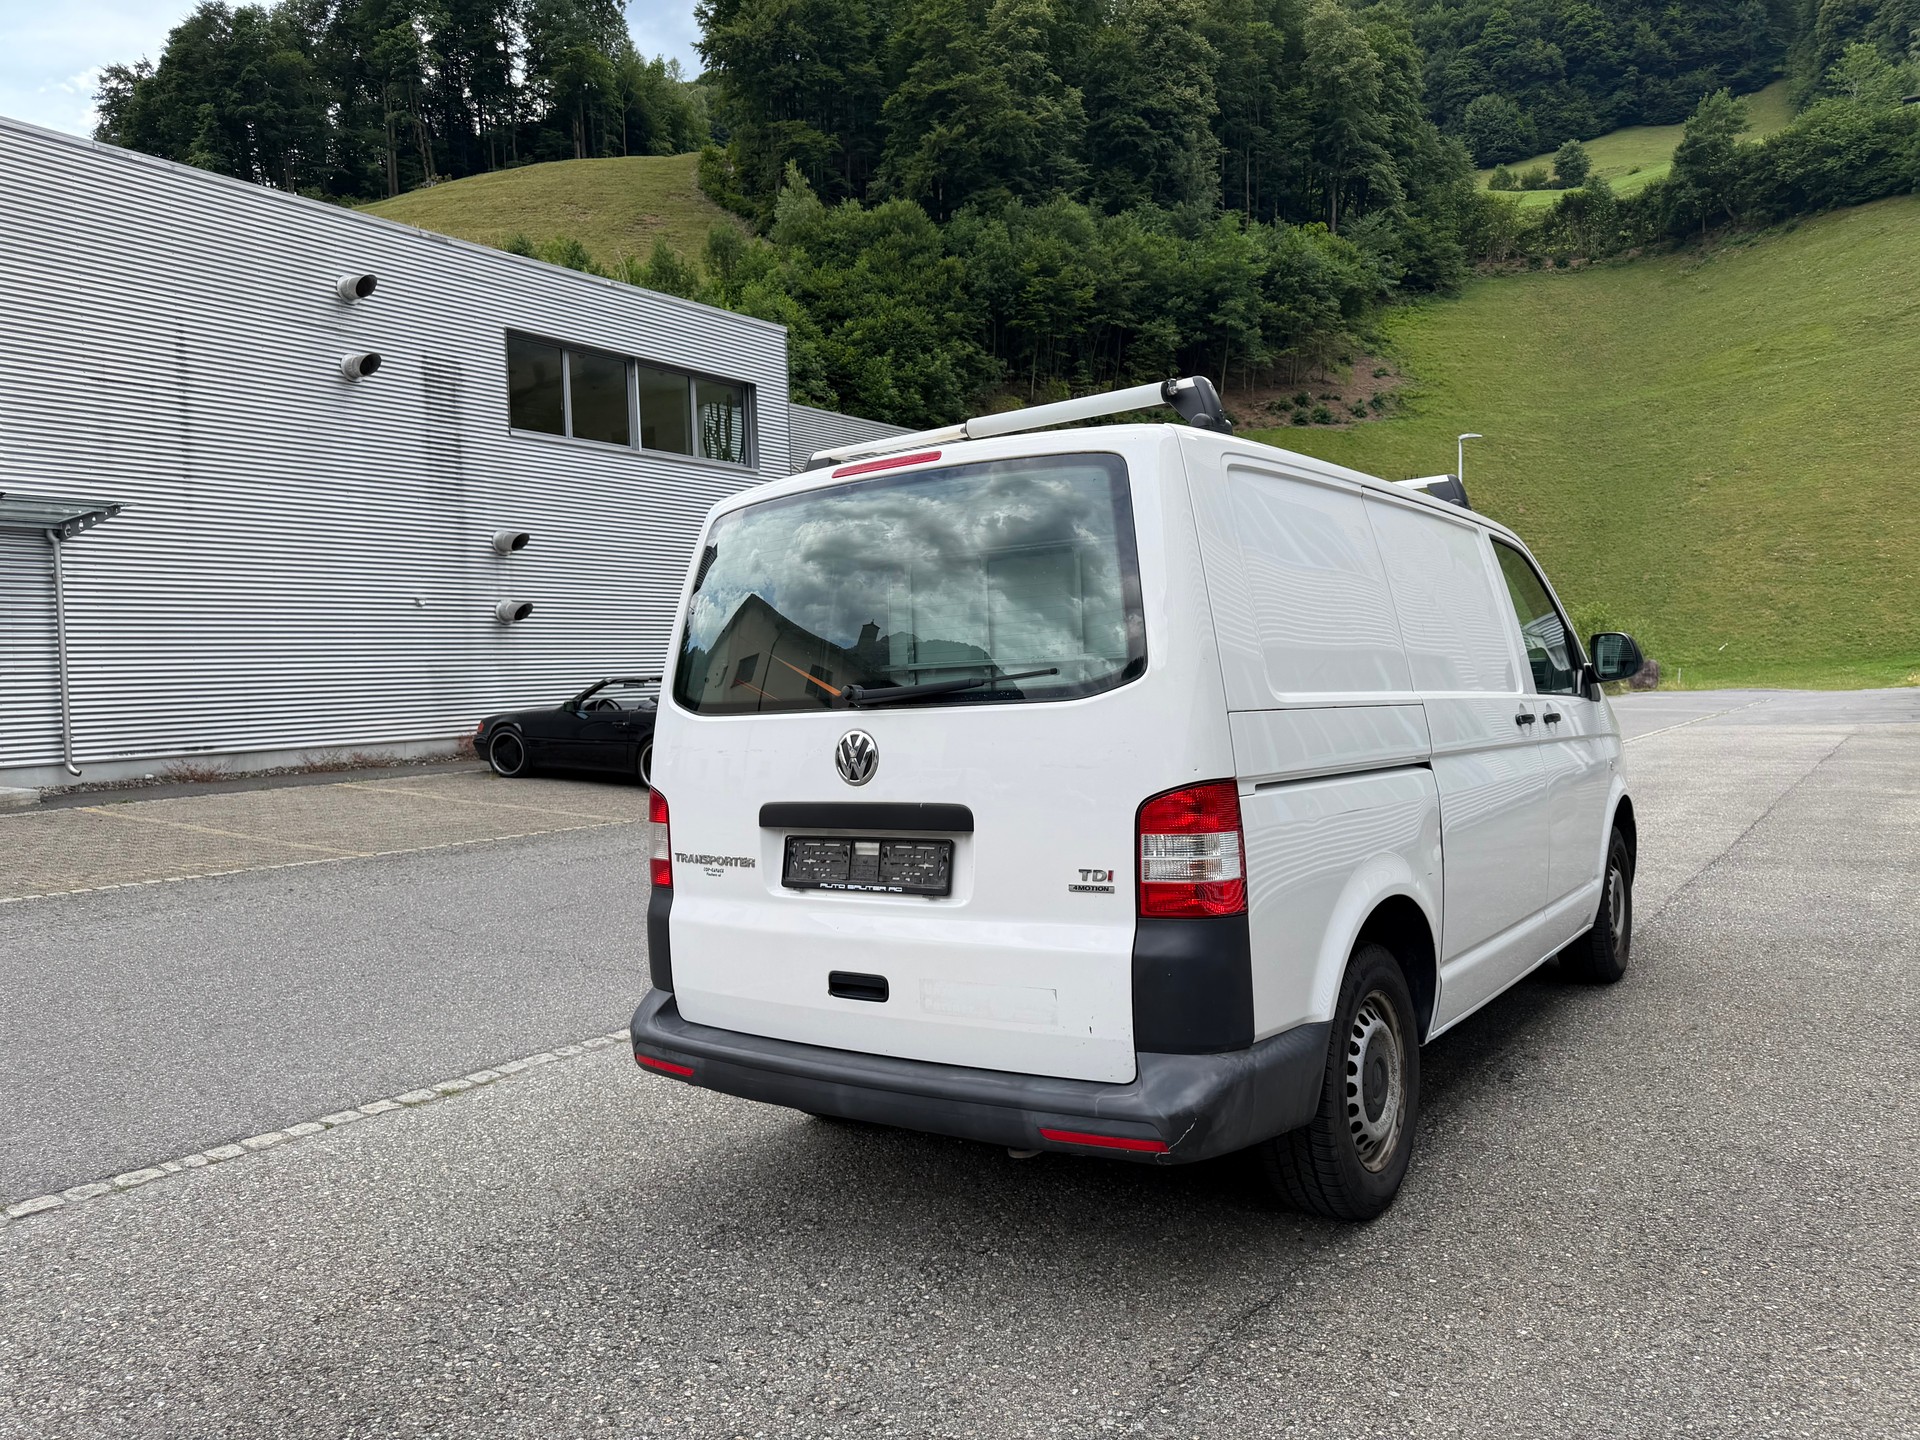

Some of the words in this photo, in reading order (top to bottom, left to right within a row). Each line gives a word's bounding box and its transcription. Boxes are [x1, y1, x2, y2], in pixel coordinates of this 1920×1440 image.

[837, 729, 878, 784] VW
[675, 853, 755, 868] TRANSPORTER
[1078, 869, 1114, 882] TDI
